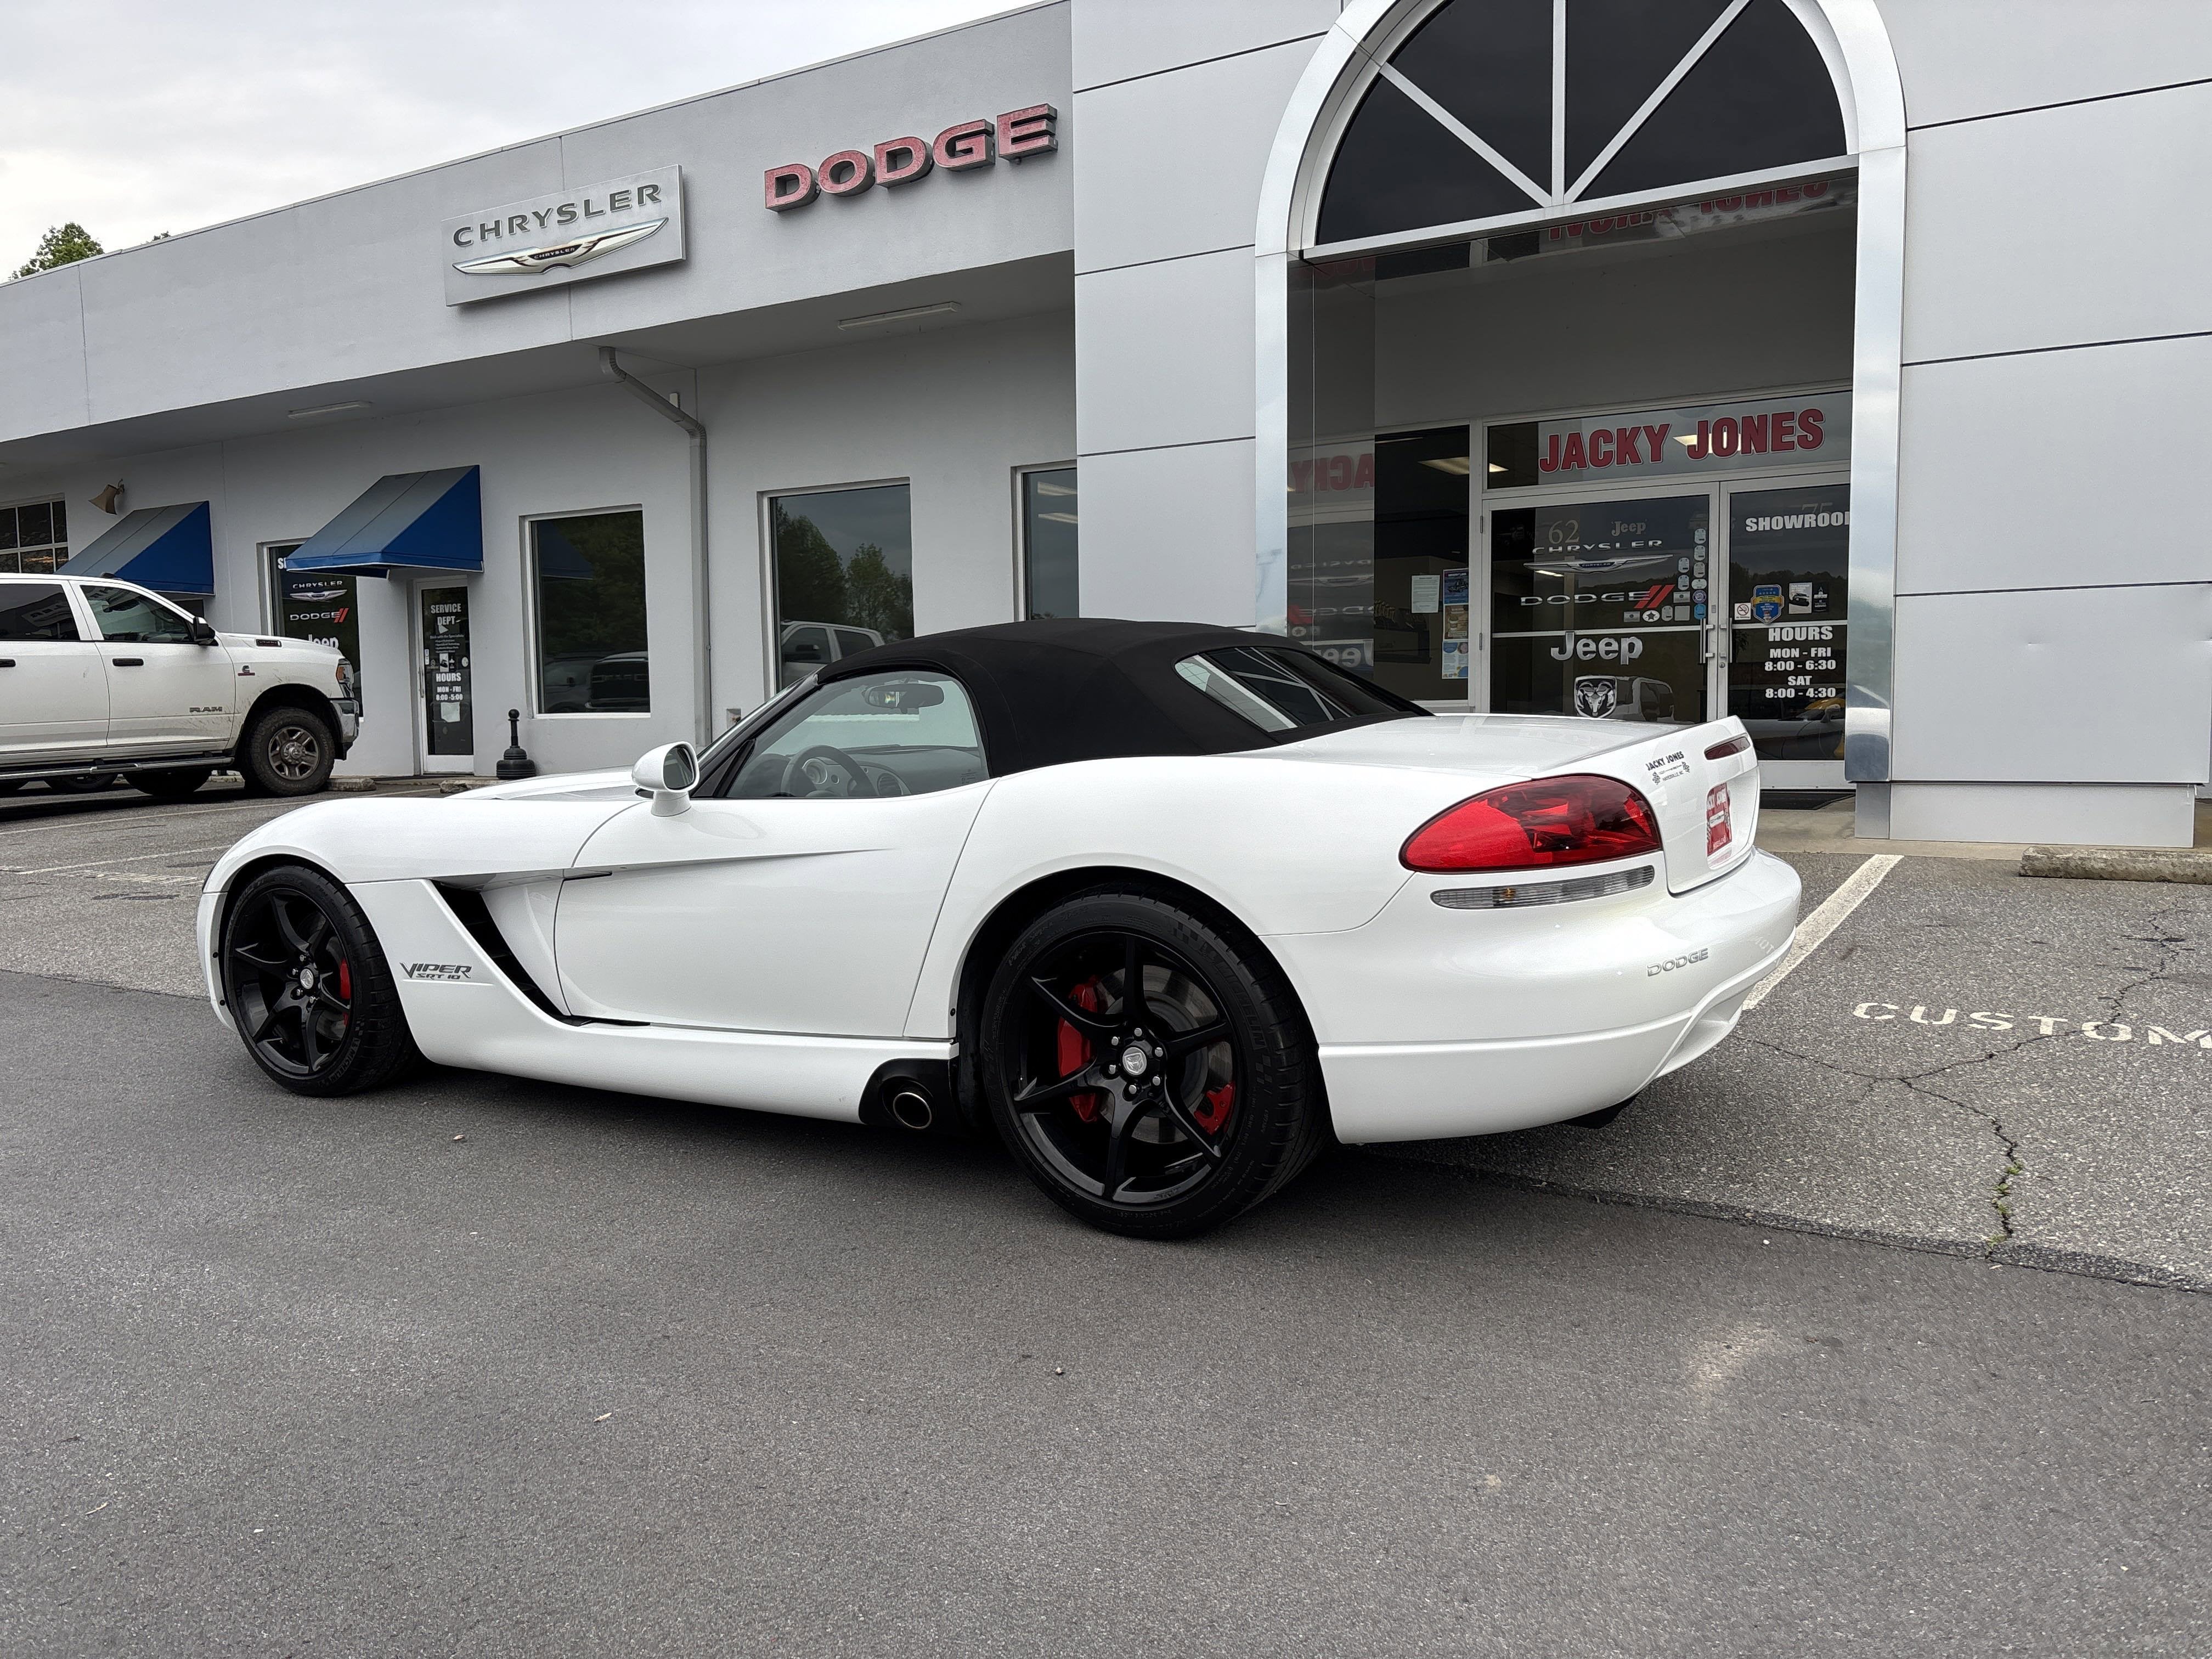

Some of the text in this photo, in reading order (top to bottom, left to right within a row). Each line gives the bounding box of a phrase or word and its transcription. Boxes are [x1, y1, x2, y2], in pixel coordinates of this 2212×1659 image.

[765, 103, 1057, 212] DODGE
[453, 184, 662, 247] CHRYSLER
[534, 247, 575, 259] CHRYSLER
[1538, 408, 1826, 473] JACKY JONES
[1548, 520, 1580, 545] 62
[1532, 539, 1663, 555] CHRYSLER
[292, 580, 343, 589] CHRYSLER
[1520, 590, 1651, 606] DODGE
[290, 611, 341, 620] DODGE
[431, 603, 461, 613] SERVICE
[437, 616, 455, 625] DEPT
[1768, 626, 1833, 641] HOURS
[1550, 631, 1643, 665] Jeep
[1769, 648, 1799, 658] MON
[1810, 647, 1831, 657] FRI
[1764, 661, 1795, 672] 8:00
[1805, 659, 1836, 670] 6:30
[436, 672, 461, 682] HOURS
[1787, 675, 1812, 686] SAT
[1765, 687, 1795, 698] 8:00
[1806, 687, 1836, 698] 4:30
[1645, 757, 1666, 771] JACKY
[1666, 751, 1684, 764] JONES
[1647, 947, 1709, 977] DODGE
[399, 962, 472, 978] VIPER
[1853, 1002, 2212, 1049] CUSTOM
